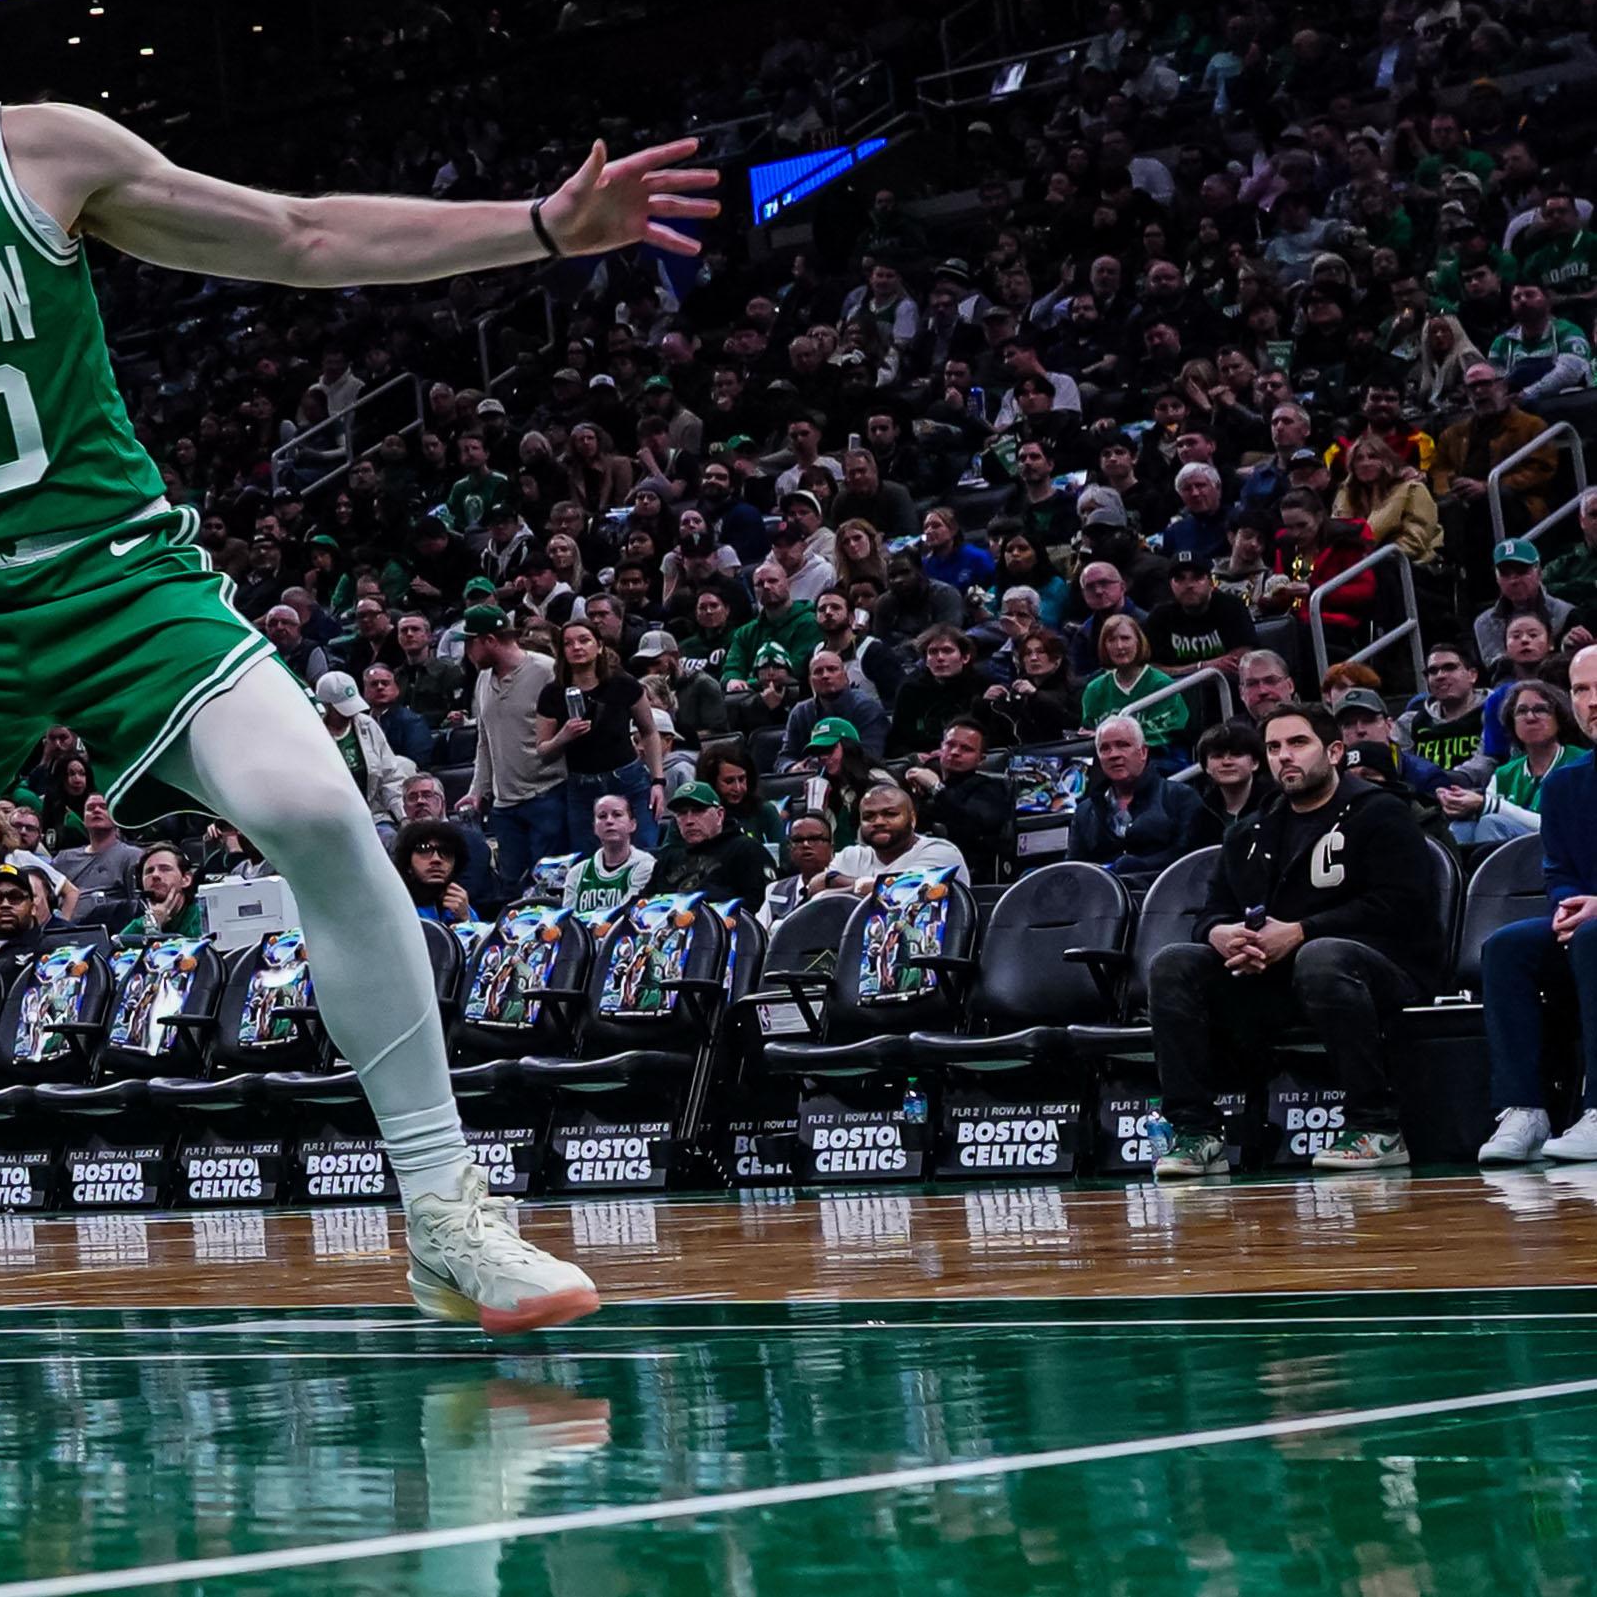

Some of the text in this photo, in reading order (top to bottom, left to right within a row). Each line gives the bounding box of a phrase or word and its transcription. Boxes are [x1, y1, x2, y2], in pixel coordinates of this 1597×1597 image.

[808, 1115, 825, 1124] FLR
[845, 1113, 867, 1122] ROW
[869, 1112, 882, 1121] AA
[952, 1107, 970, 1117] FLR
[972, 1107, 979, 1116] 2
[991, 1106, 1014, 1116] ROW
[1017, 1105, 1031, 1115] AA
[1042, 1104, 1067, 1115] SEAT
[1286, 1106, 1345, 1130] BOS
[504, 1129, 525, 1139] SEAT
[595, 1125, 617, 1134] ROW
[618, 1124, 631, 1133] AA
[640, 1123, 660, 1133] SEAT
[815, 1149, 907, 1172] CELTICS
[959, 1144, 1058, 1167] CELTICS
[567, 1159, 652, 1182] CELTICS
[73, 1182, 144, 1202] CELTICS
[189, 1178, 262, 1199] CELTICS
[308, 1174, 385, 1195] CELTICS
